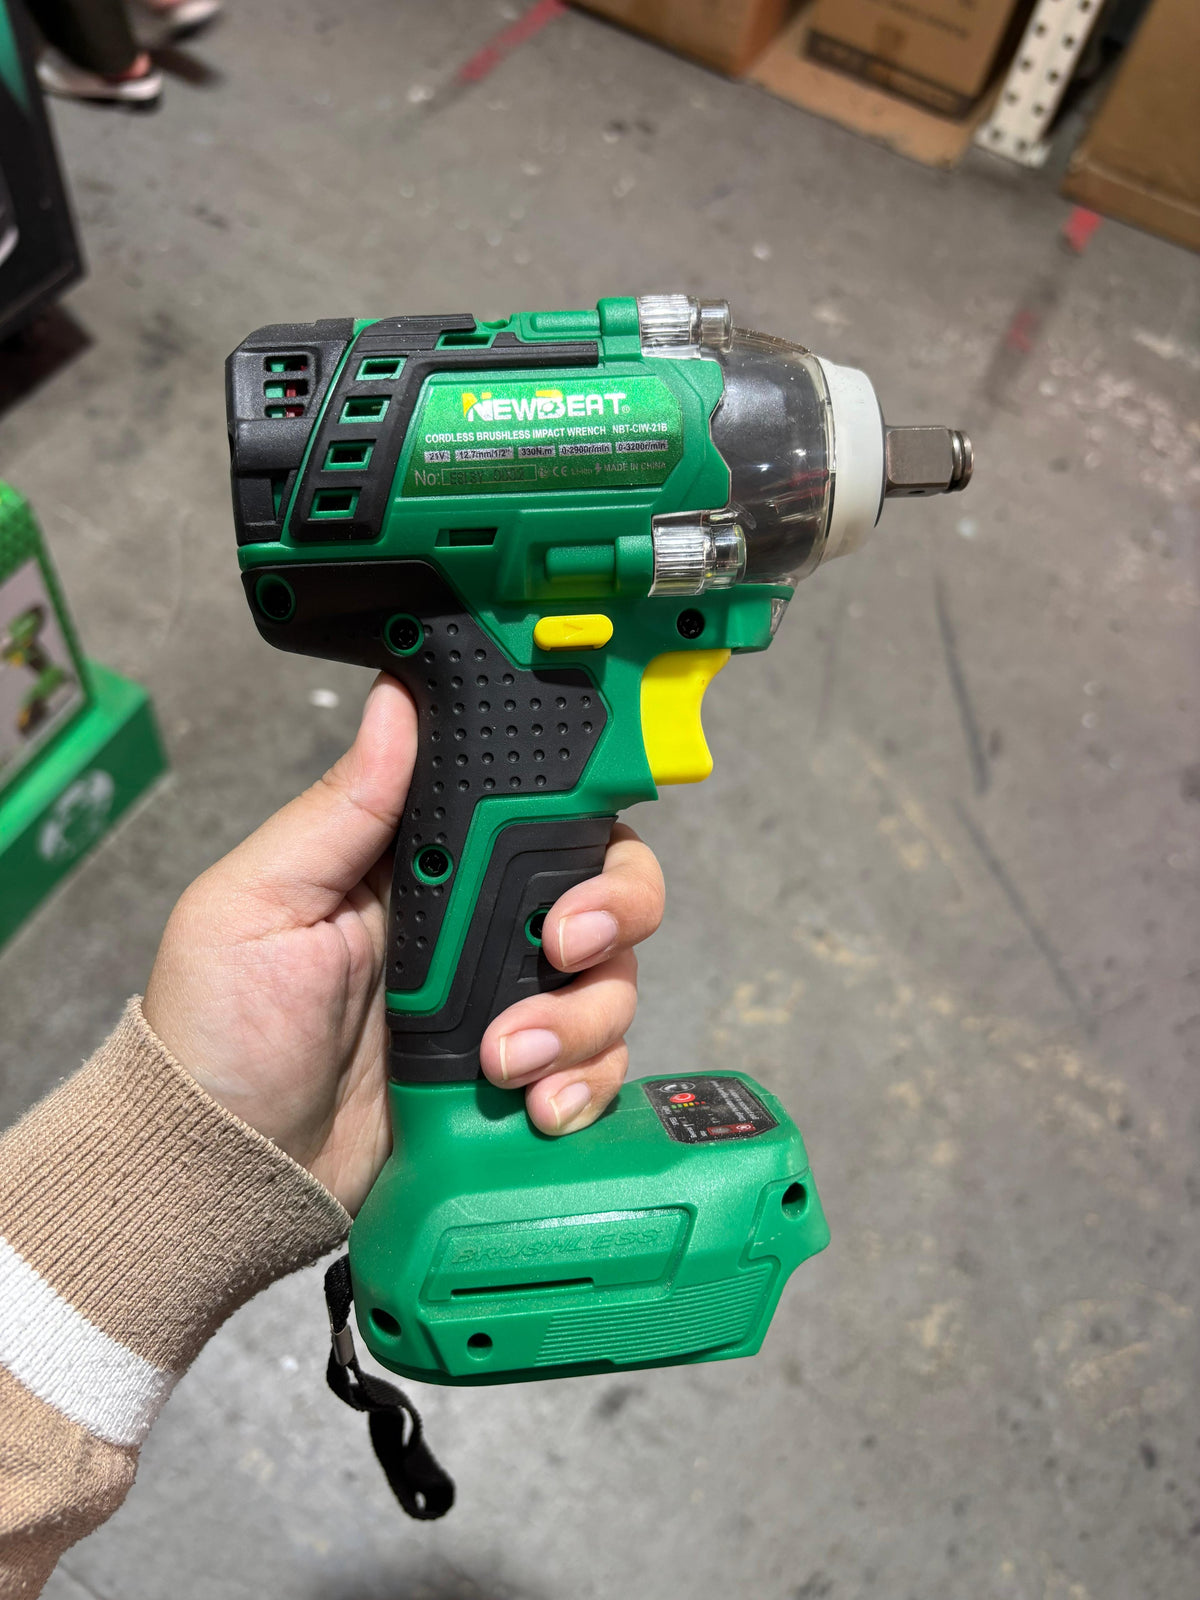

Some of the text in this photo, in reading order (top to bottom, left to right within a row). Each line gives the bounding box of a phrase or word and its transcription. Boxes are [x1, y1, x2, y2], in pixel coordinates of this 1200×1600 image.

[425, 423, 668, 444] CORDLESS BRUSHLESS IMPACT WRENCH NBT-CIW-21B
[429, 452, 445, 461] 21V
[521, 446, 552, 456] 330N.m
[603, 462, 628, 472] MADE
[630, 461, 639, 471] IN
[641, 461, 667, 471] CHINA
[414, 469, 440, 486] No:
[451, 1229, 662, 1264] BRUSHLESS
